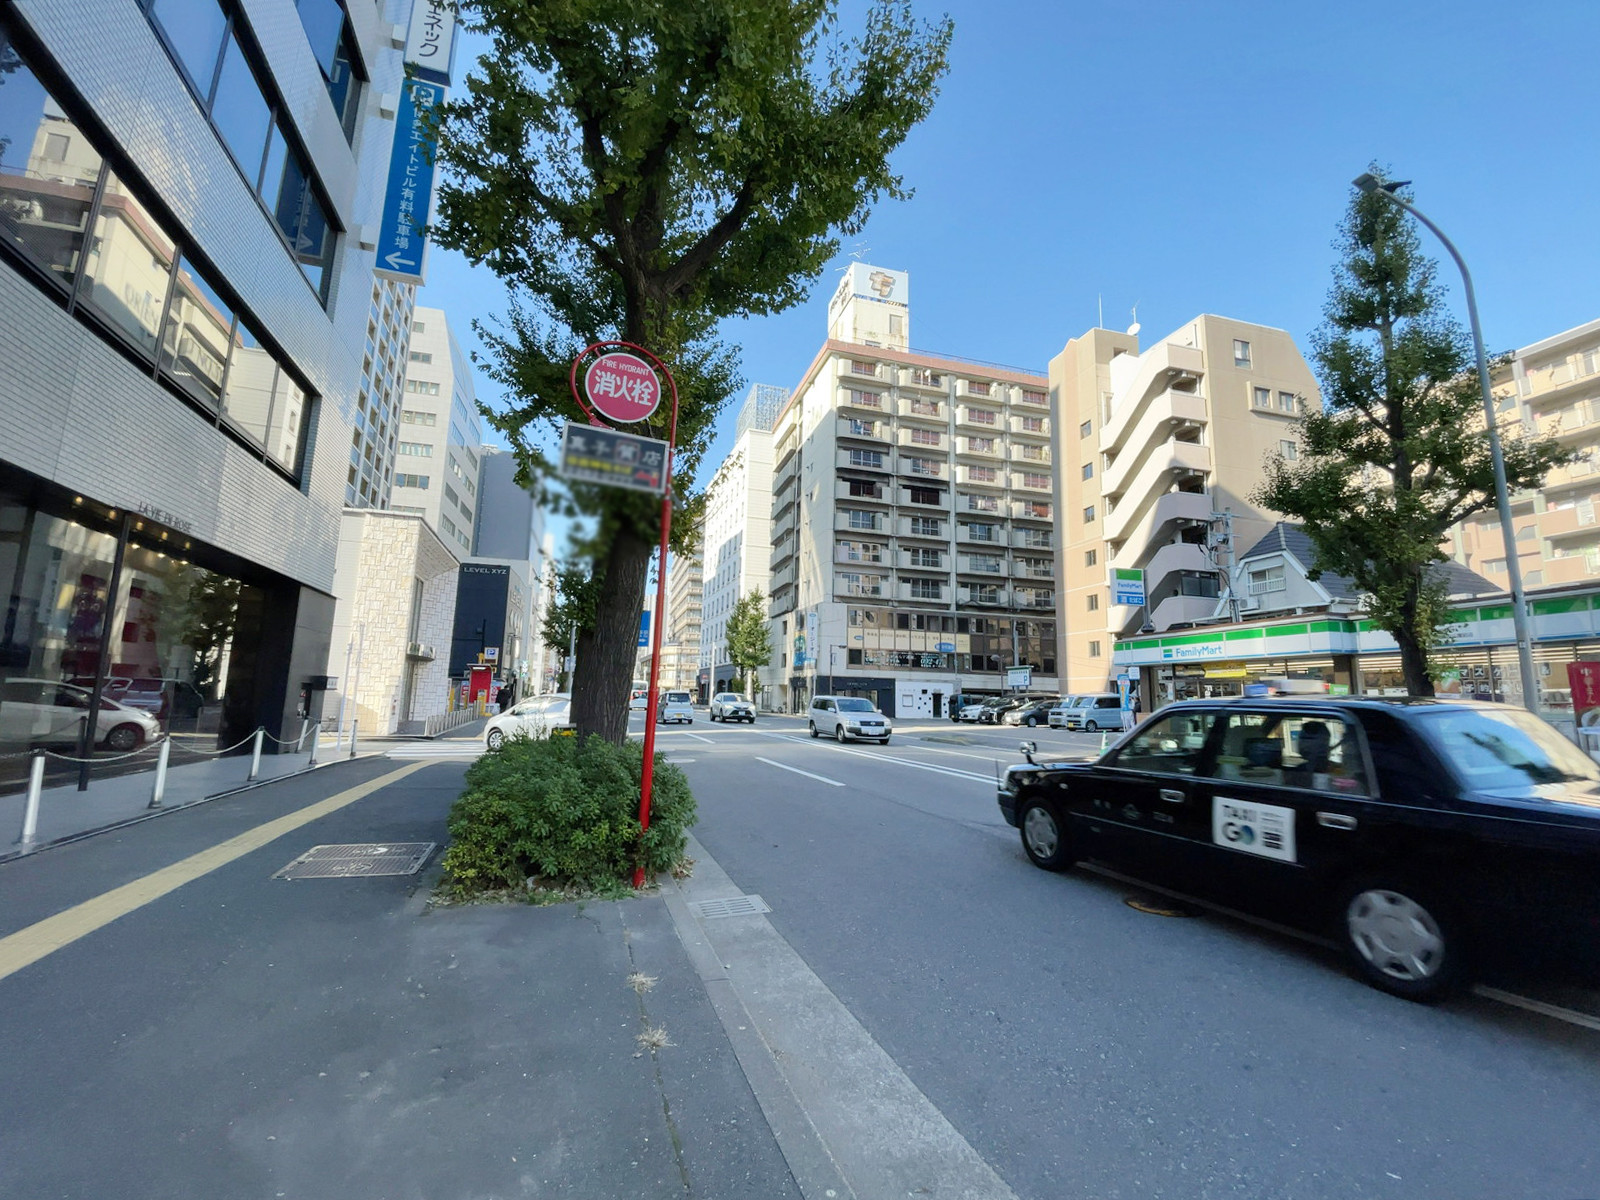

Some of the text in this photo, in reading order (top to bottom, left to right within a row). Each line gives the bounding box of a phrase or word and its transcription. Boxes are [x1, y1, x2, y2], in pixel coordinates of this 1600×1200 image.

[602, 358, 649, 376] FIRE HYDRANT
[593, 369, 654, 406] 消火栓
[1117, 582, 1142, 590] FamilyMart
[1176, 645, 1222, 657] FamilyMart
